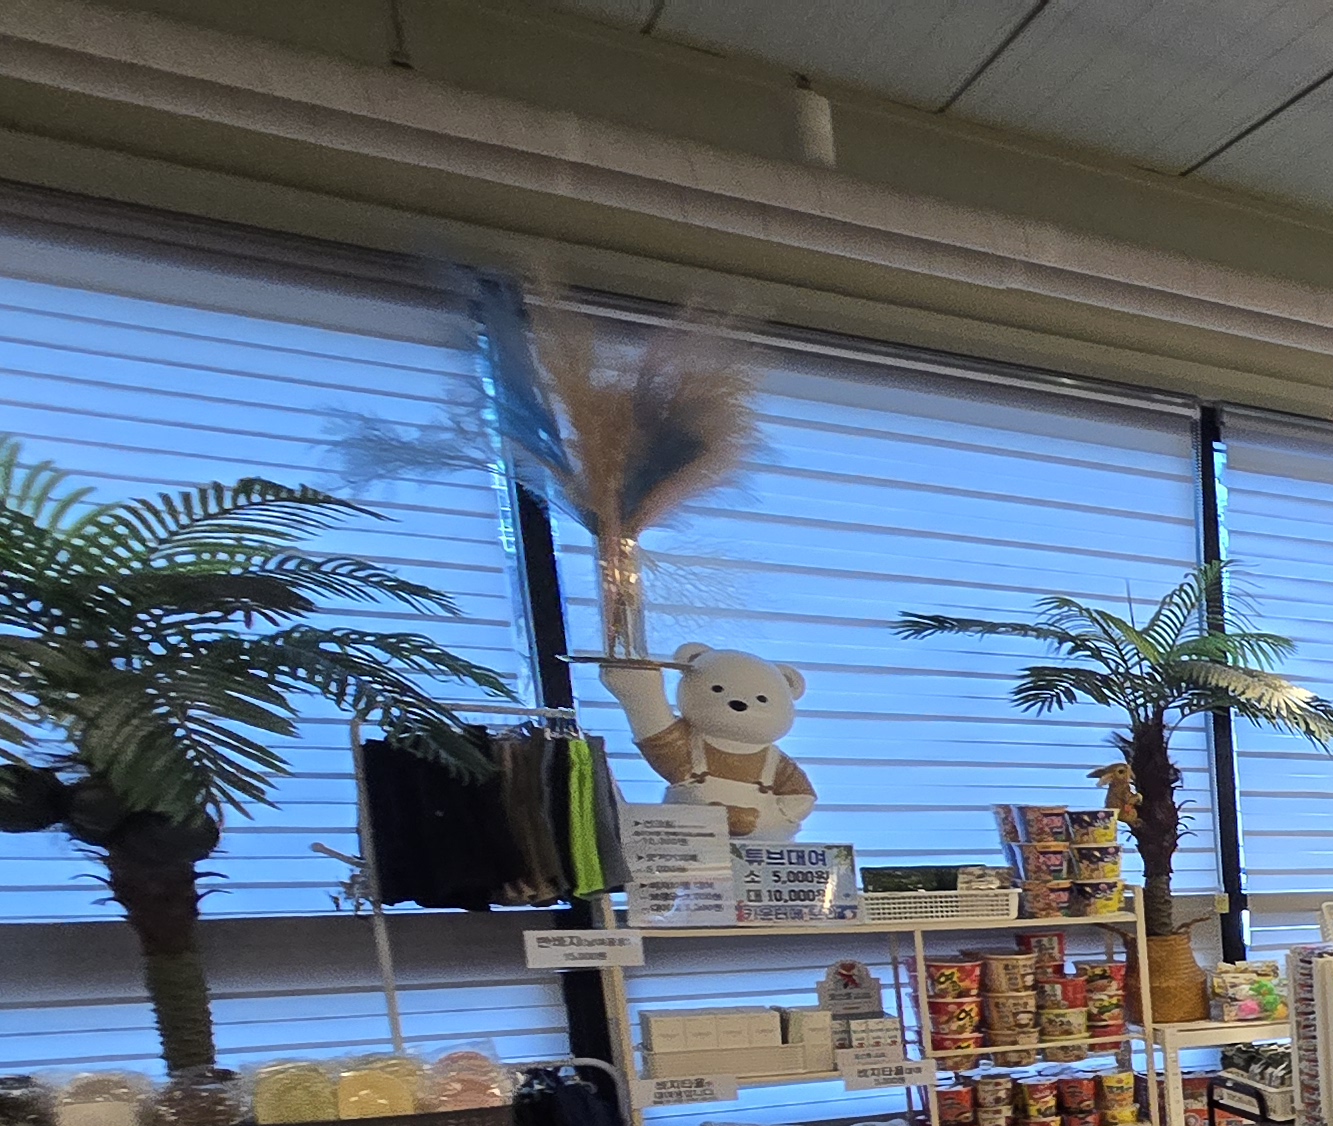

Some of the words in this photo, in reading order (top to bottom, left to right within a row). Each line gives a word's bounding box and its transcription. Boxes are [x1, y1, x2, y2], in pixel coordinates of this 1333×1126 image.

[744, 848, 828, 867] 튜브대여
[743, 870, 761, 884] 소
[771, 869, 829, 885] 5,000원
[746, 890, 762, 903] 대
